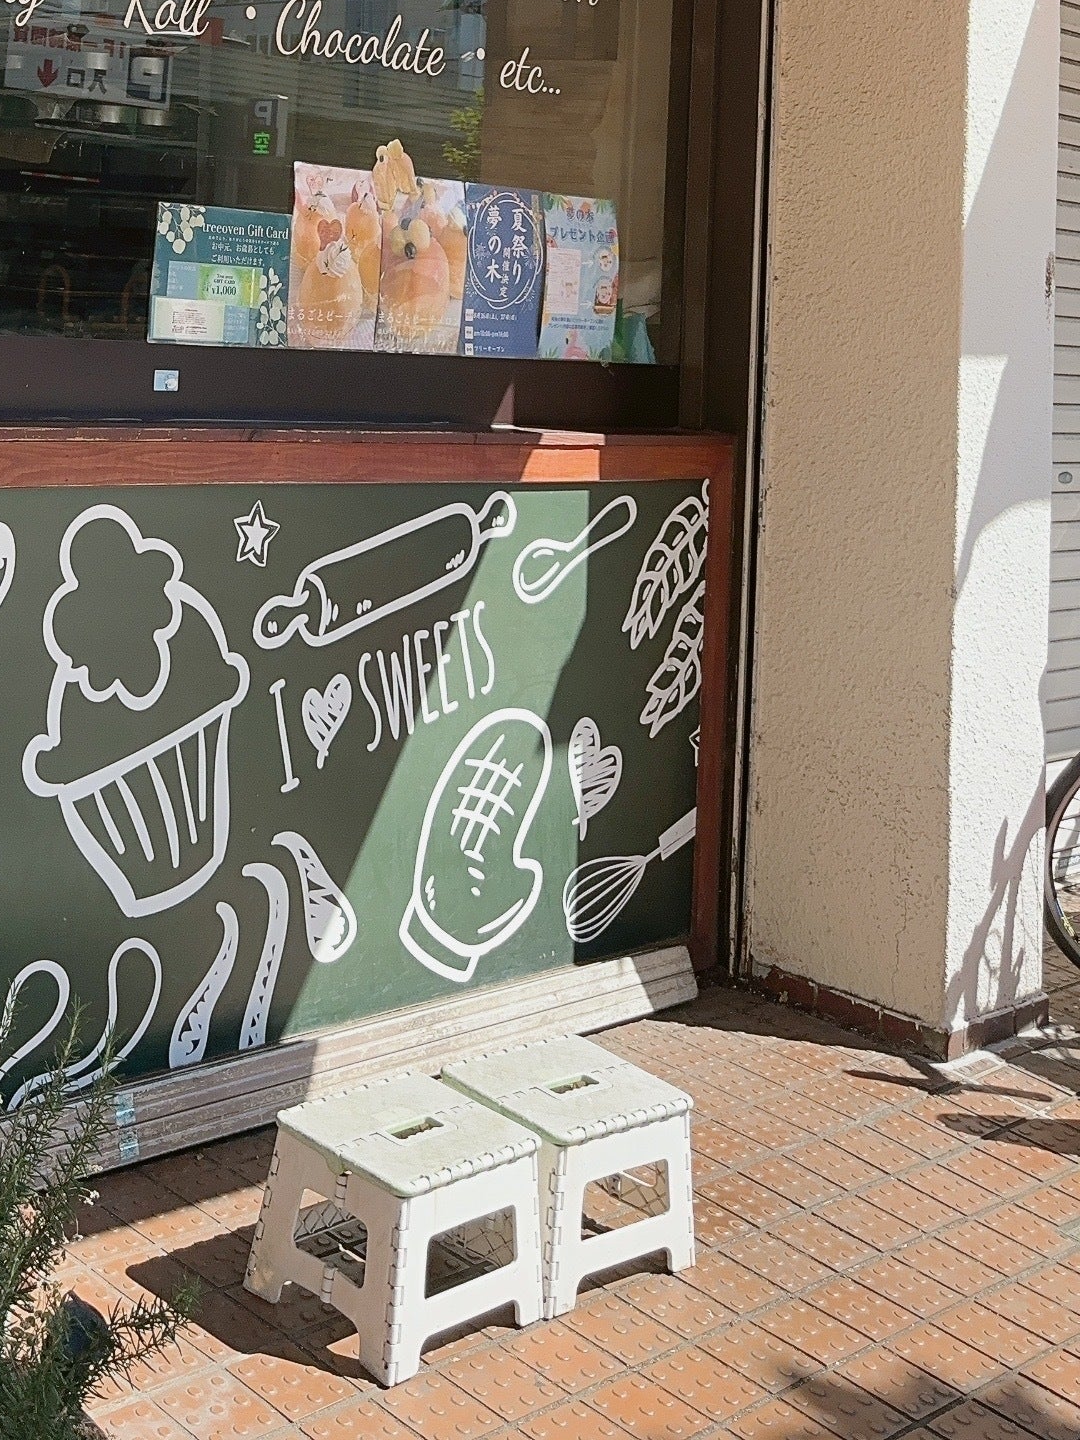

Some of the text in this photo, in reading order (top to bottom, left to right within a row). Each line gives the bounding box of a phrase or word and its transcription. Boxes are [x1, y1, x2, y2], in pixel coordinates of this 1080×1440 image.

[500, 47, 562, 96] etc...
[202, 223, 289, 240] treeoven Gift Card
[485, 205, 502, 283] 夢の木
[511, 208, 529, 285] 夏祭り
[499, 247, 511, 298] 開催決定
[269, 600, 496, 793] I SWEETS
